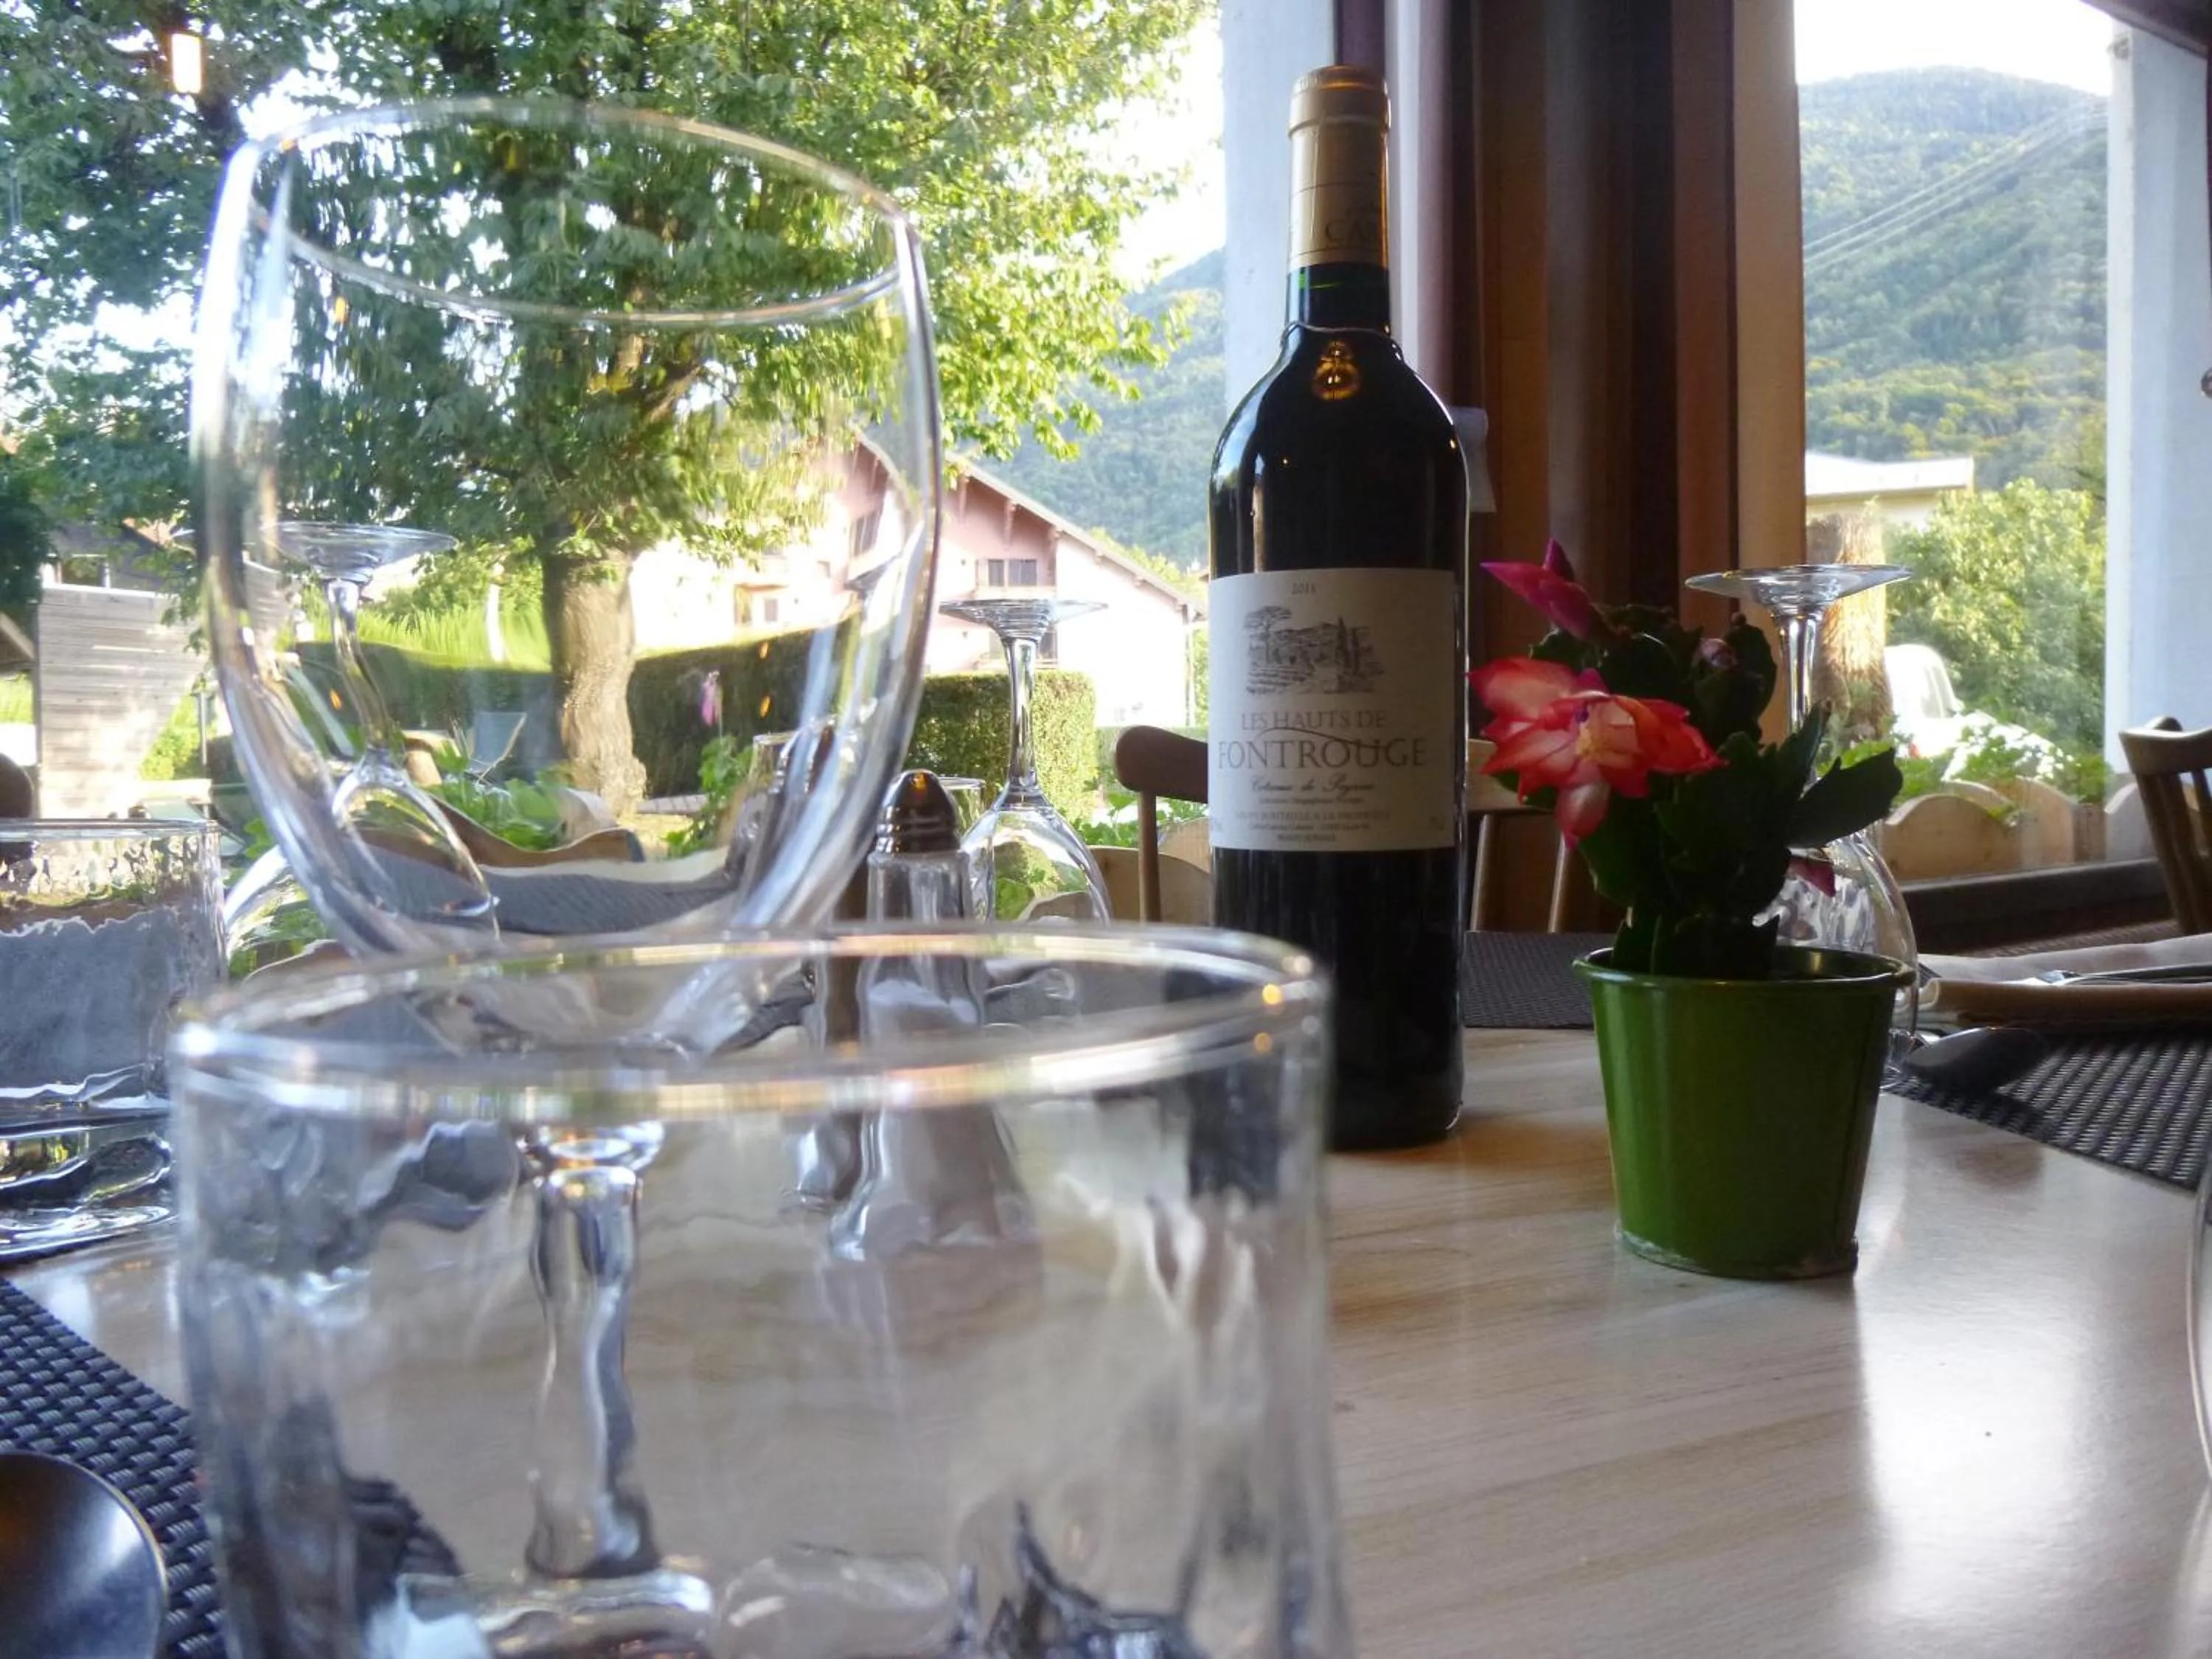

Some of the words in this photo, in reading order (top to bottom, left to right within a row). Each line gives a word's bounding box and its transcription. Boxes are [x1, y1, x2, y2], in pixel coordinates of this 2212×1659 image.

[1241, 713, 1268, 731] LES
[1274, 710, 1350, 730] HAUTS
[1356, 709, 1388, 728] DE
[1218, 737, 1426, 769] FONTROUGE
